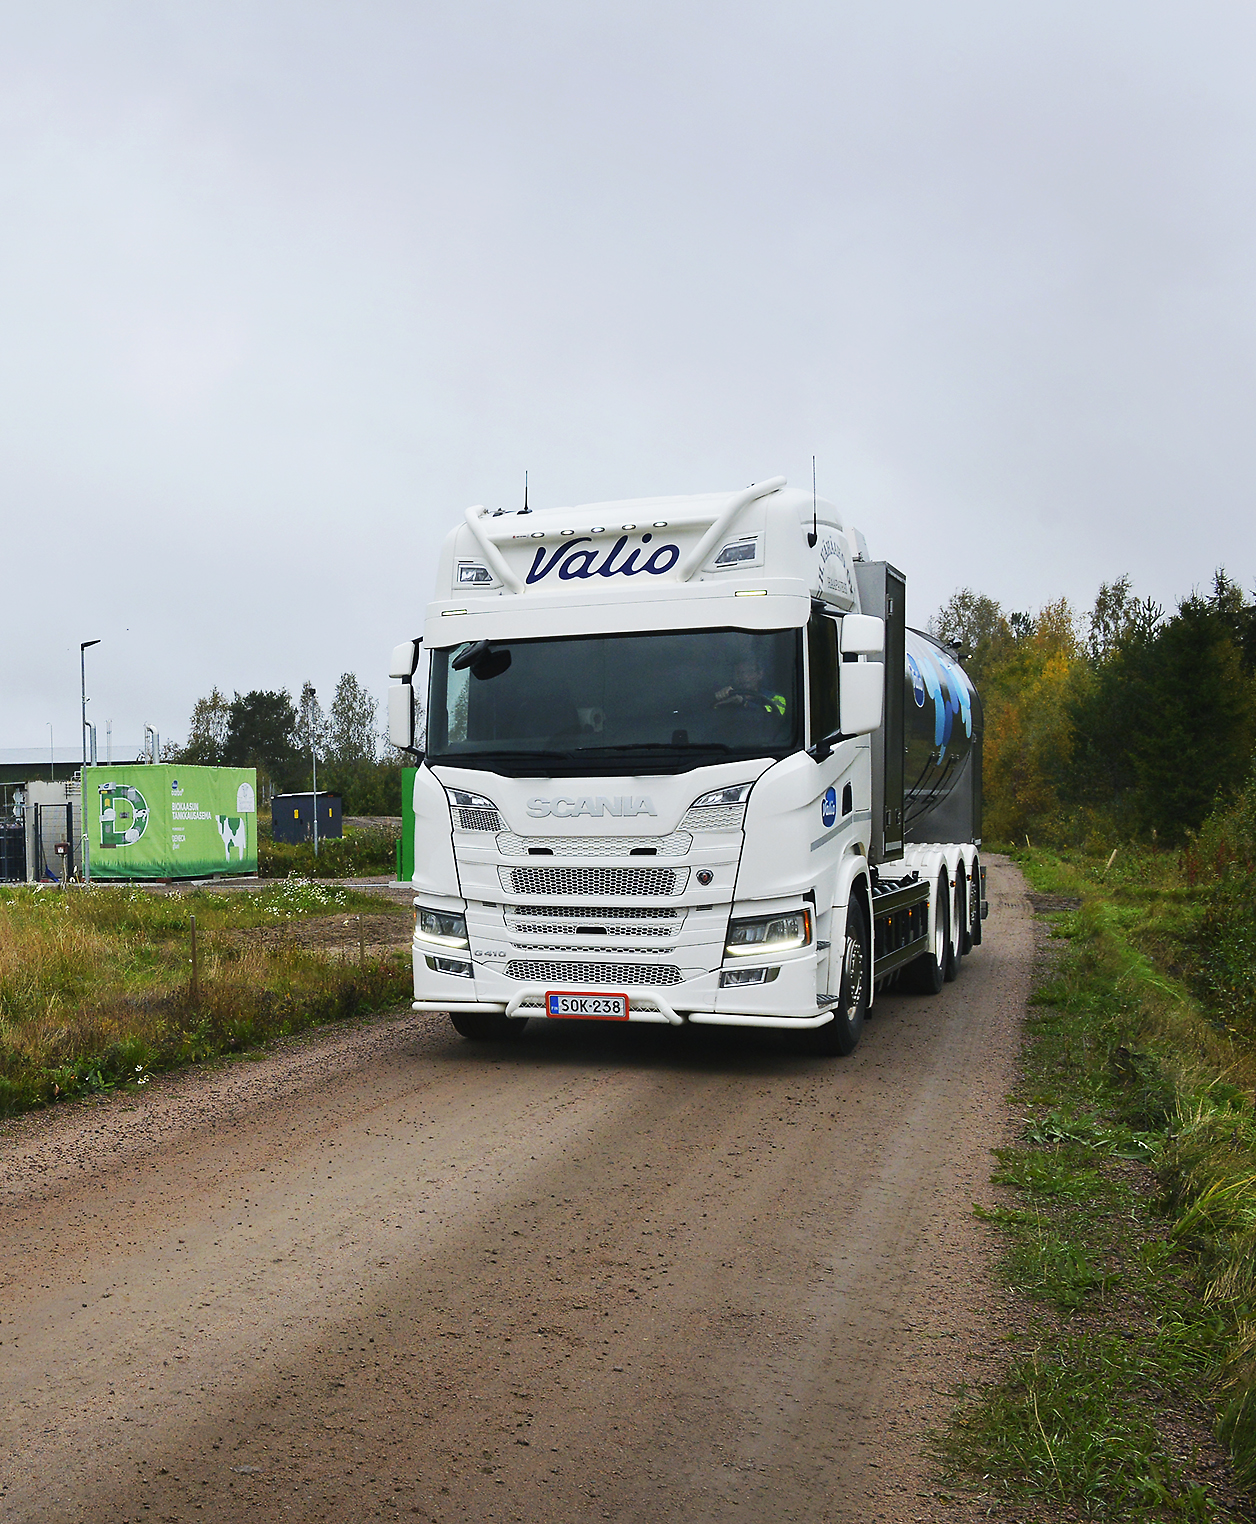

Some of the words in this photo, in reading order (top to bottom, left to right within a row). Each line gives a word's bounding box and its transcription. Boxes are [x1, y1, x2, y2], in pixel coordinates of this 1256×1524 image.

[526, 533, 680, 585] Valio
[526, 796, 658, 818] SCANIA
[821, 799, 837, 817] Valio
[474, 949, 507, 958] G410
[561, 998, 621, 1014] SOK-238
